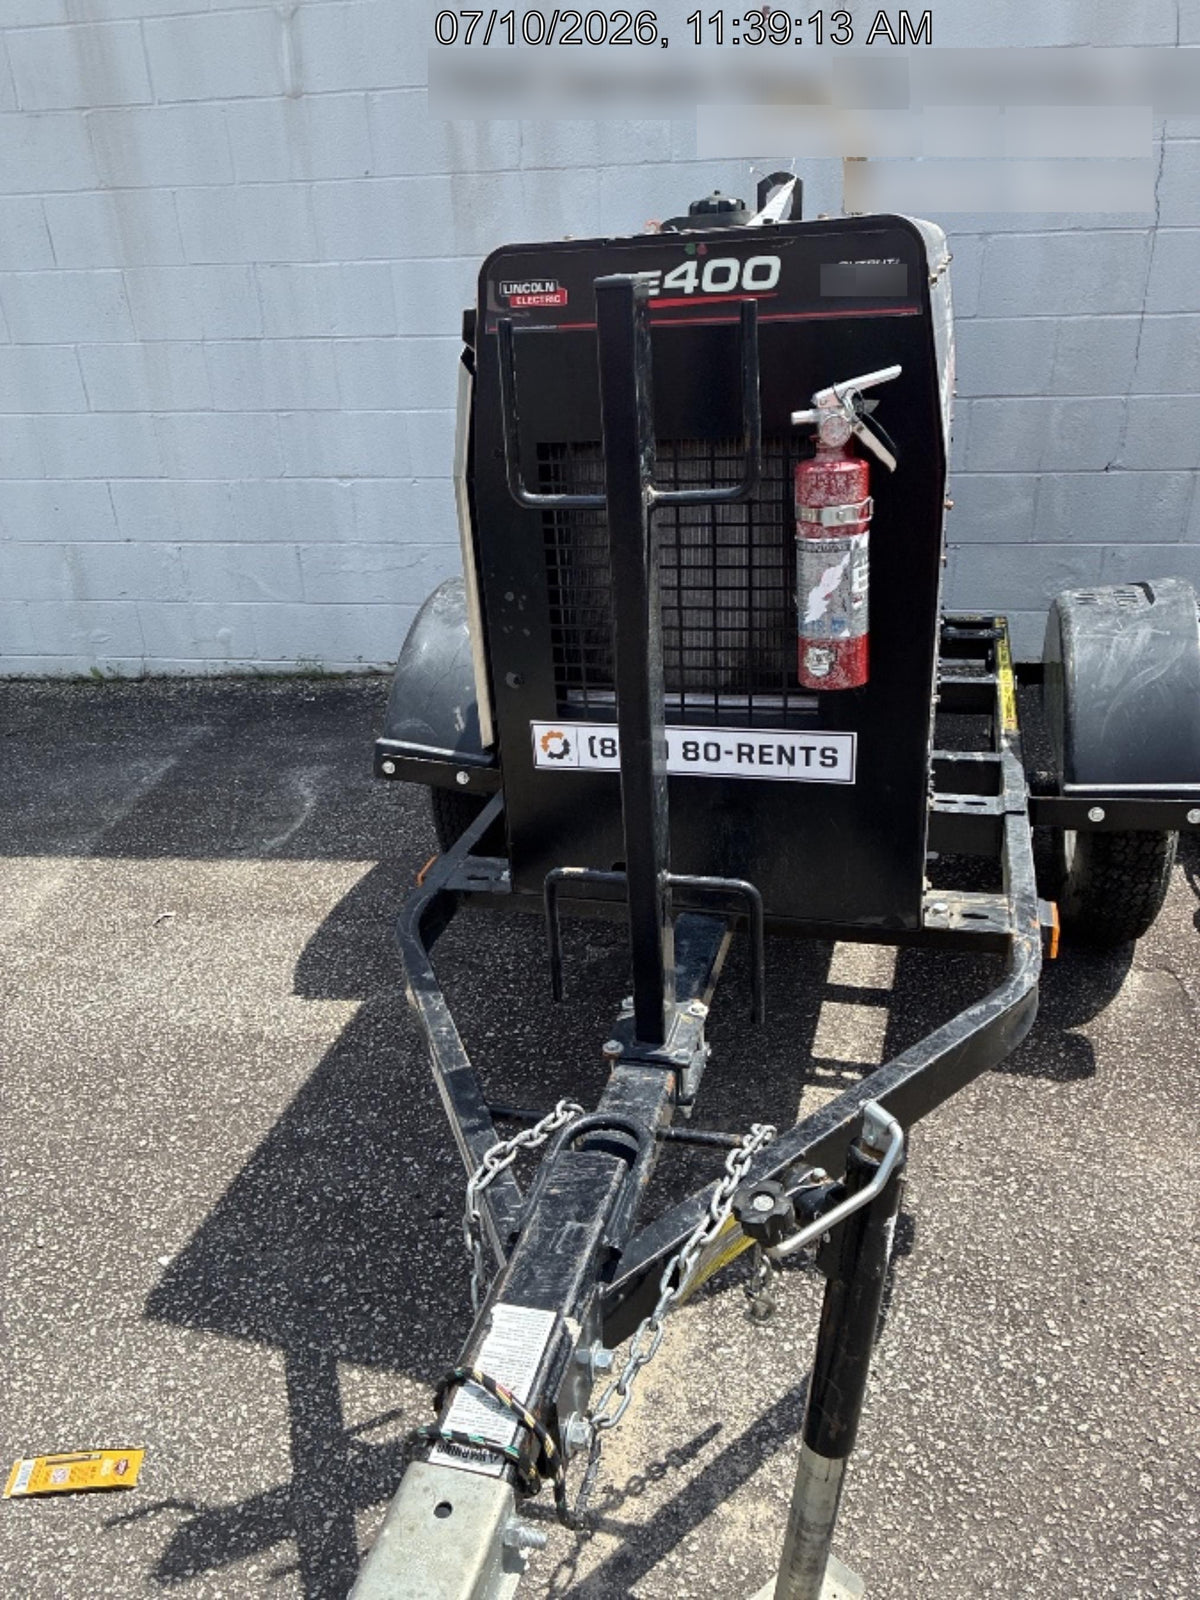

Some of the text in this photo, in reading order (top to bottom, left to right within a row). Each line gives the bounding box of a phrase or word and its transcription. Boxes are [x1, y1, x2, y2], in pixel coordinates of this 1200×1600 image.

[502, 281, 556, 295] LINCOLN
[516, 294, 561, 305] ELECTRIC
[682, 740, 838, 769] 80-RENTS
